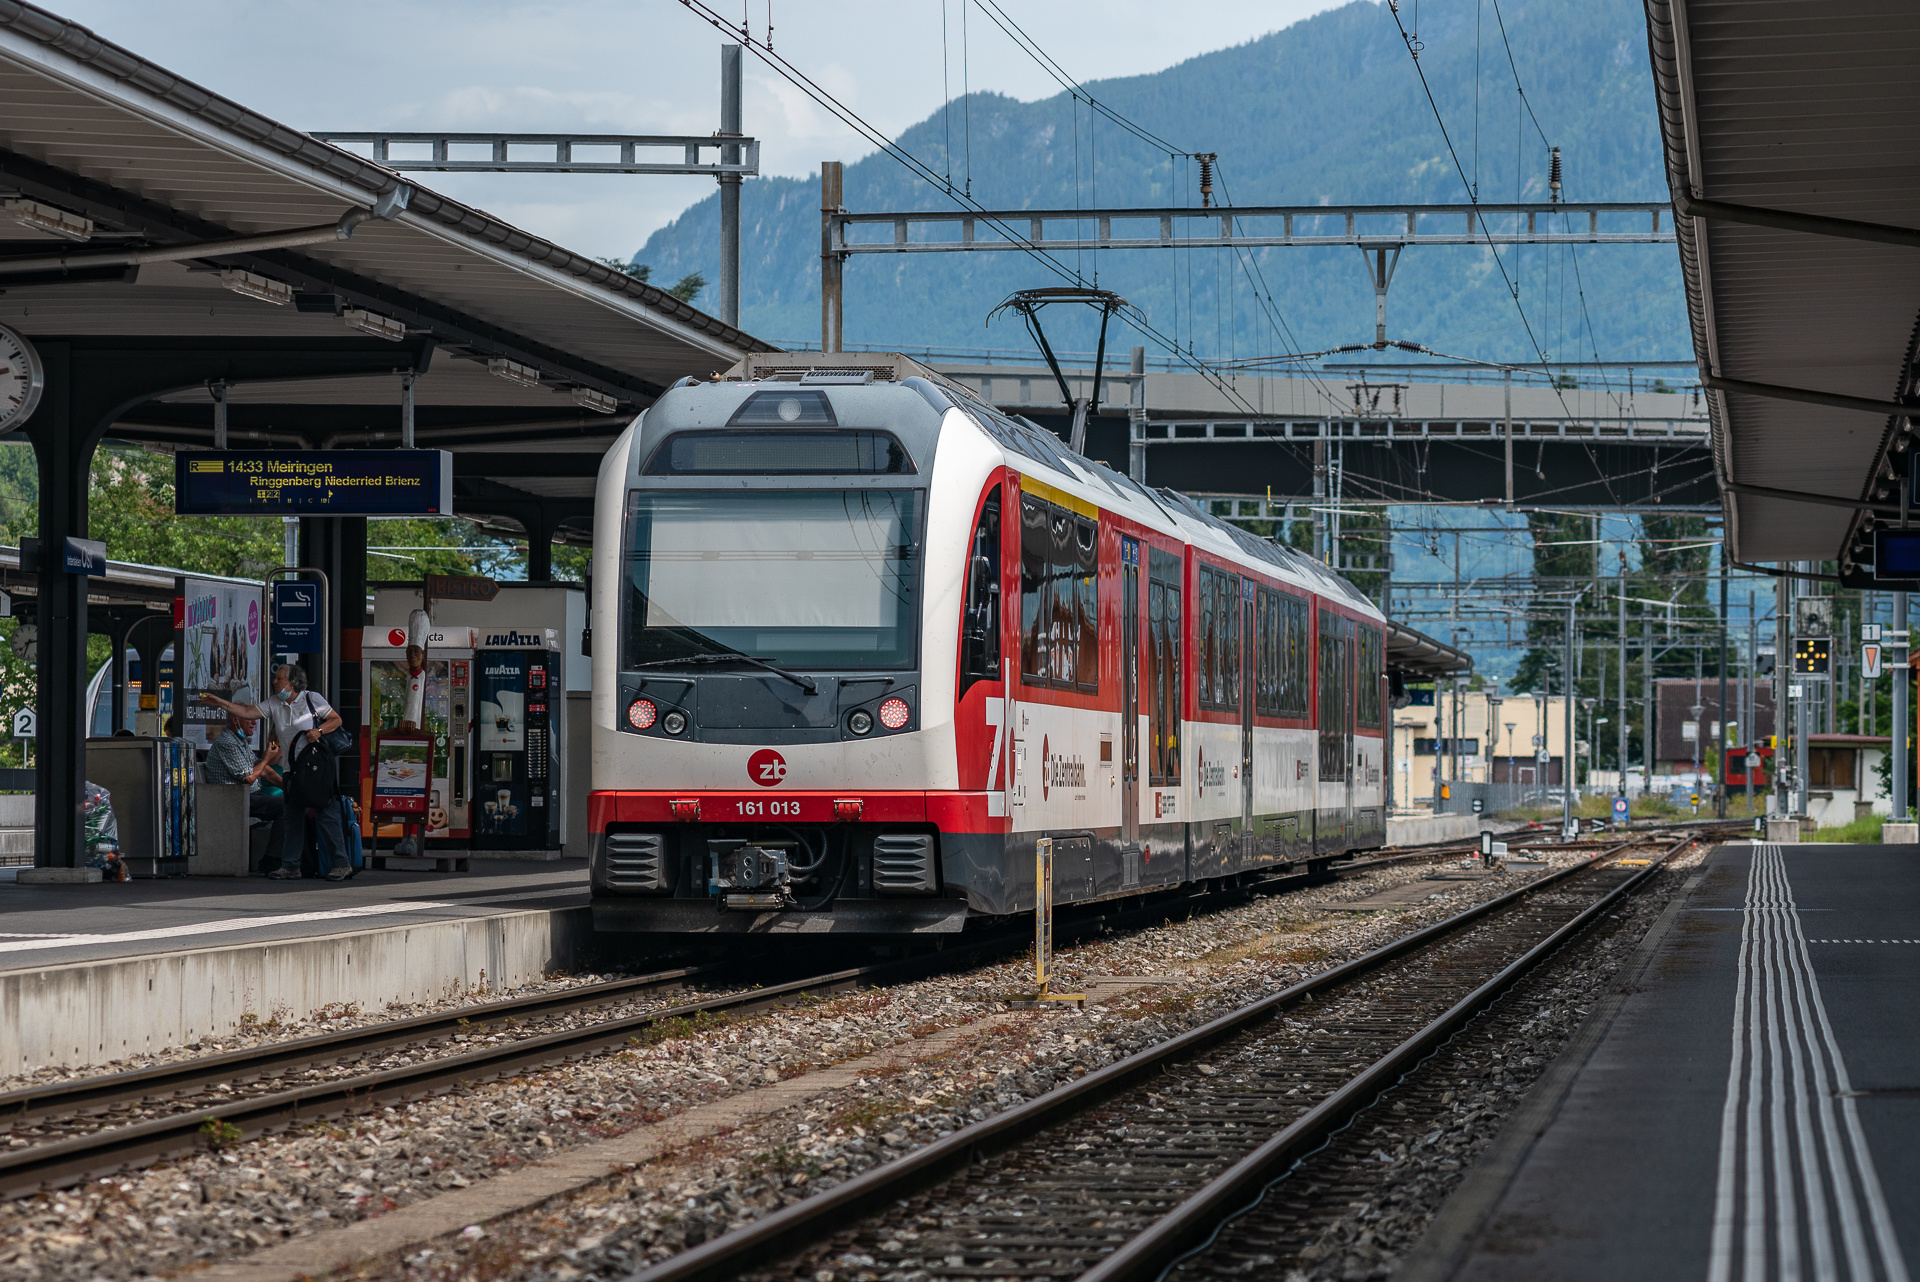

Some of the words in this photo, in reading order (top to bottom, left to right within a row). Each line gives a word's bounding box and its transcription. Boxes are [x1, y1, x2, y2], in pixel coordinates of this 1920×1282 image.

[190, 462, 199, 471] R
[228, 461, 263, 473] 14:33
[267, 461, 333, 475] Meiringen
[250, 476, 321, 488] Ringgenberg
[325, 476, 381, 486] Niederried
[385, 476, 420, 486] Brienz
[436, 579, 491, 596] BISTRO
[485, 631, 541, 646] LAVAZZA
[1869, 626, 1873, 639] 1
[485, 664, 521, 675] LAVAZZA
[1422, 694, 1430, 704] 4
[19, 715, 32, 733] 2
[759, 759, 787, 779] zb
[736, 801, 763, 815] 161
[770, 801, 801, 815] 013
